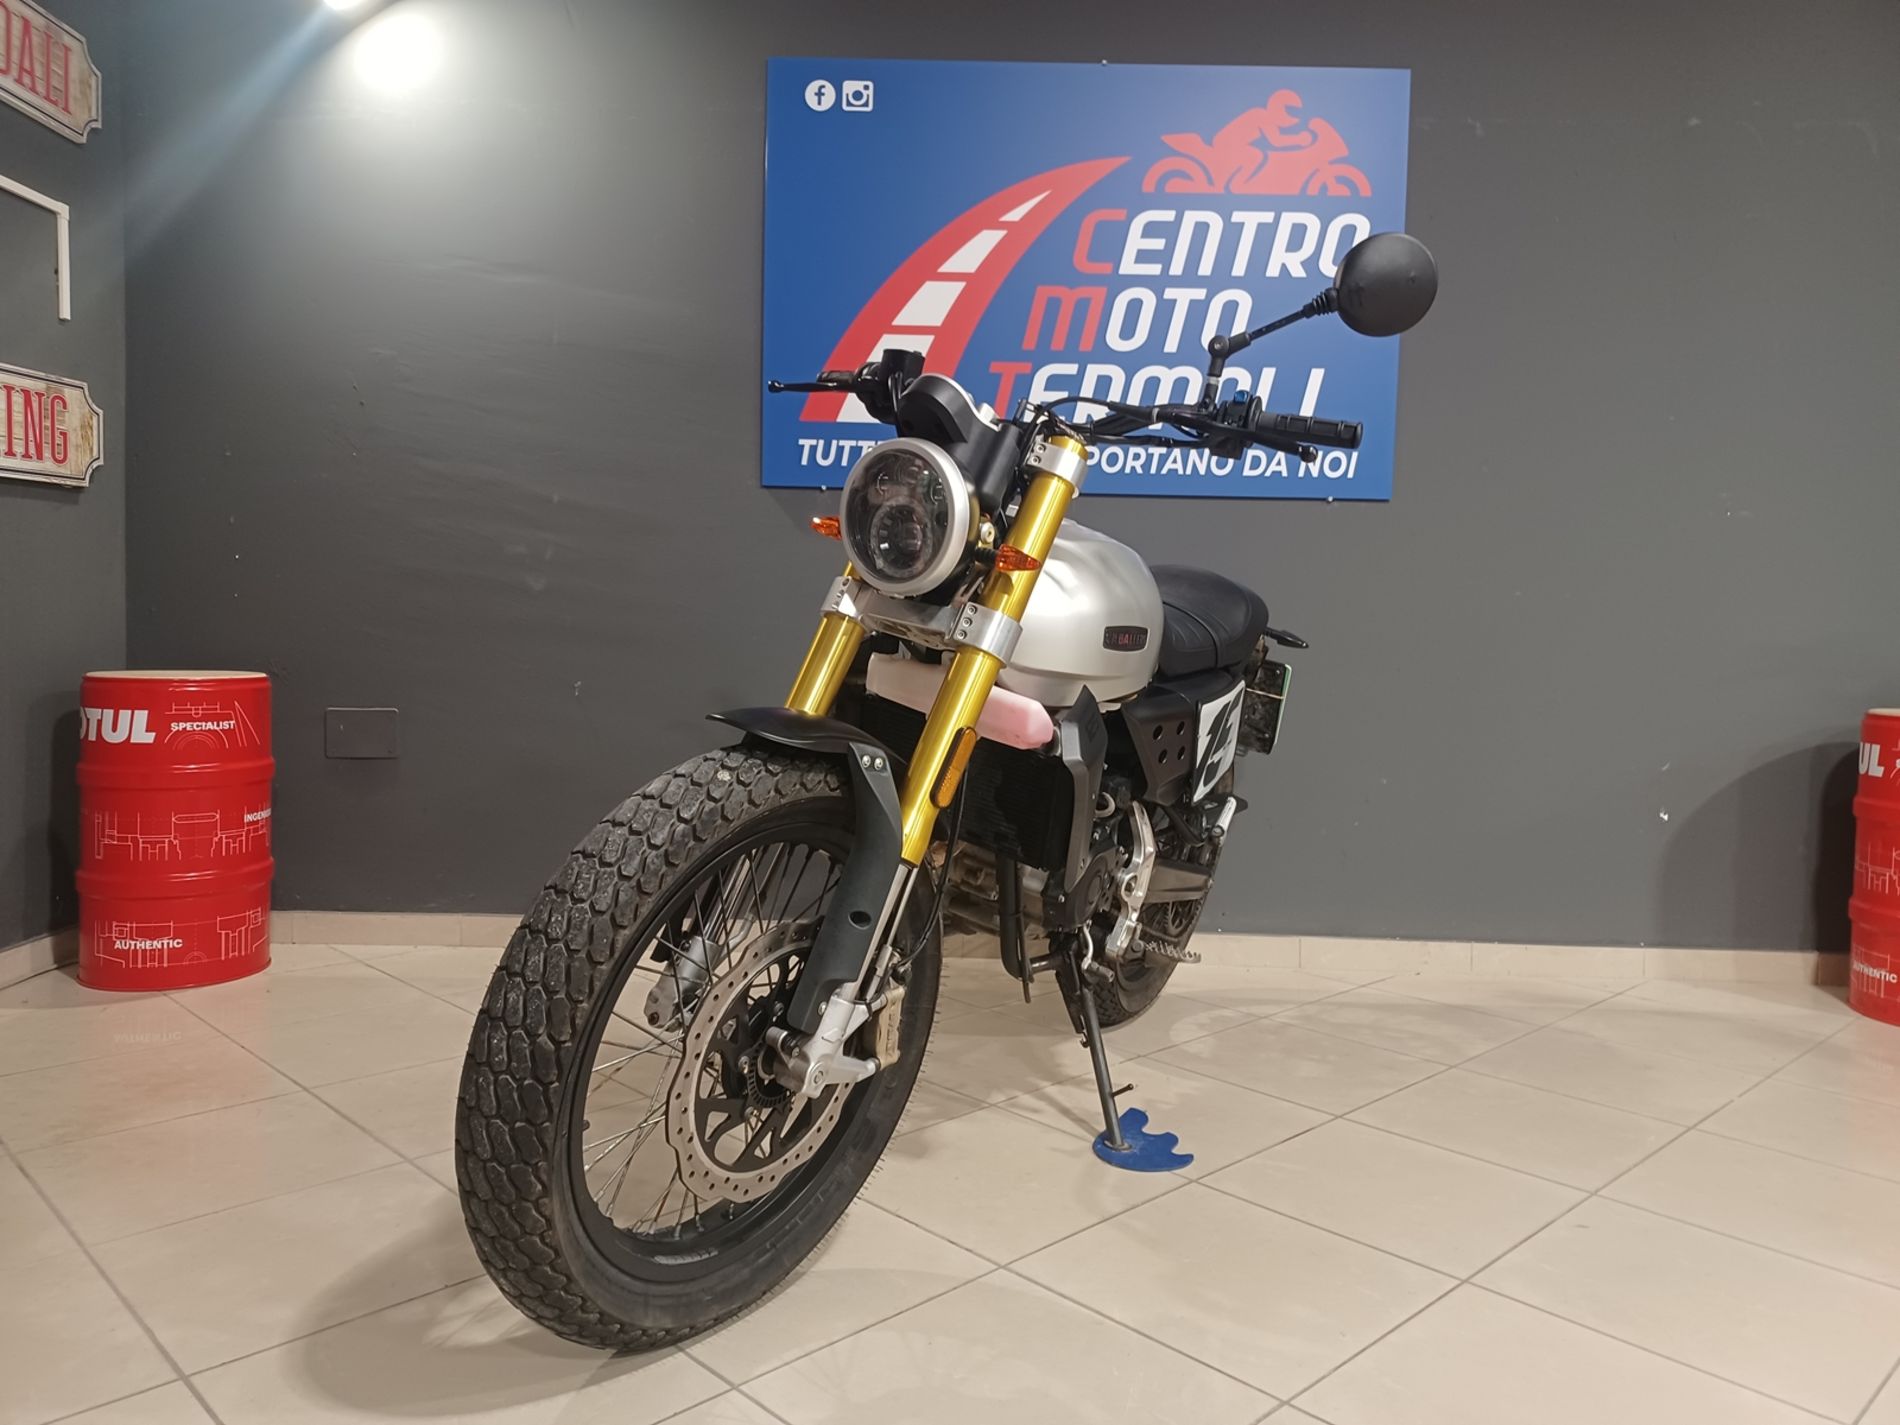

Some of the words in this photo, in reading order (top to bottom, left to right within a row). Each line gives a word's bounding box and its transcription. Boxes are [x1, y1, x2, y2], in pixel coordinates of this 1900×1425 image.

[1072, 208, 1371, 278] CENTRO
[1022, 285, 1252, 353] MOTO
[798, 438, 887, 467] TUTT
[1242, 448, 1289, 477] DA
[1298, 450, 1359, 479] NOI
[170, 720, 236, 731] SPECIALIST
[114, 939, 183, 950] AUTHENTIC
